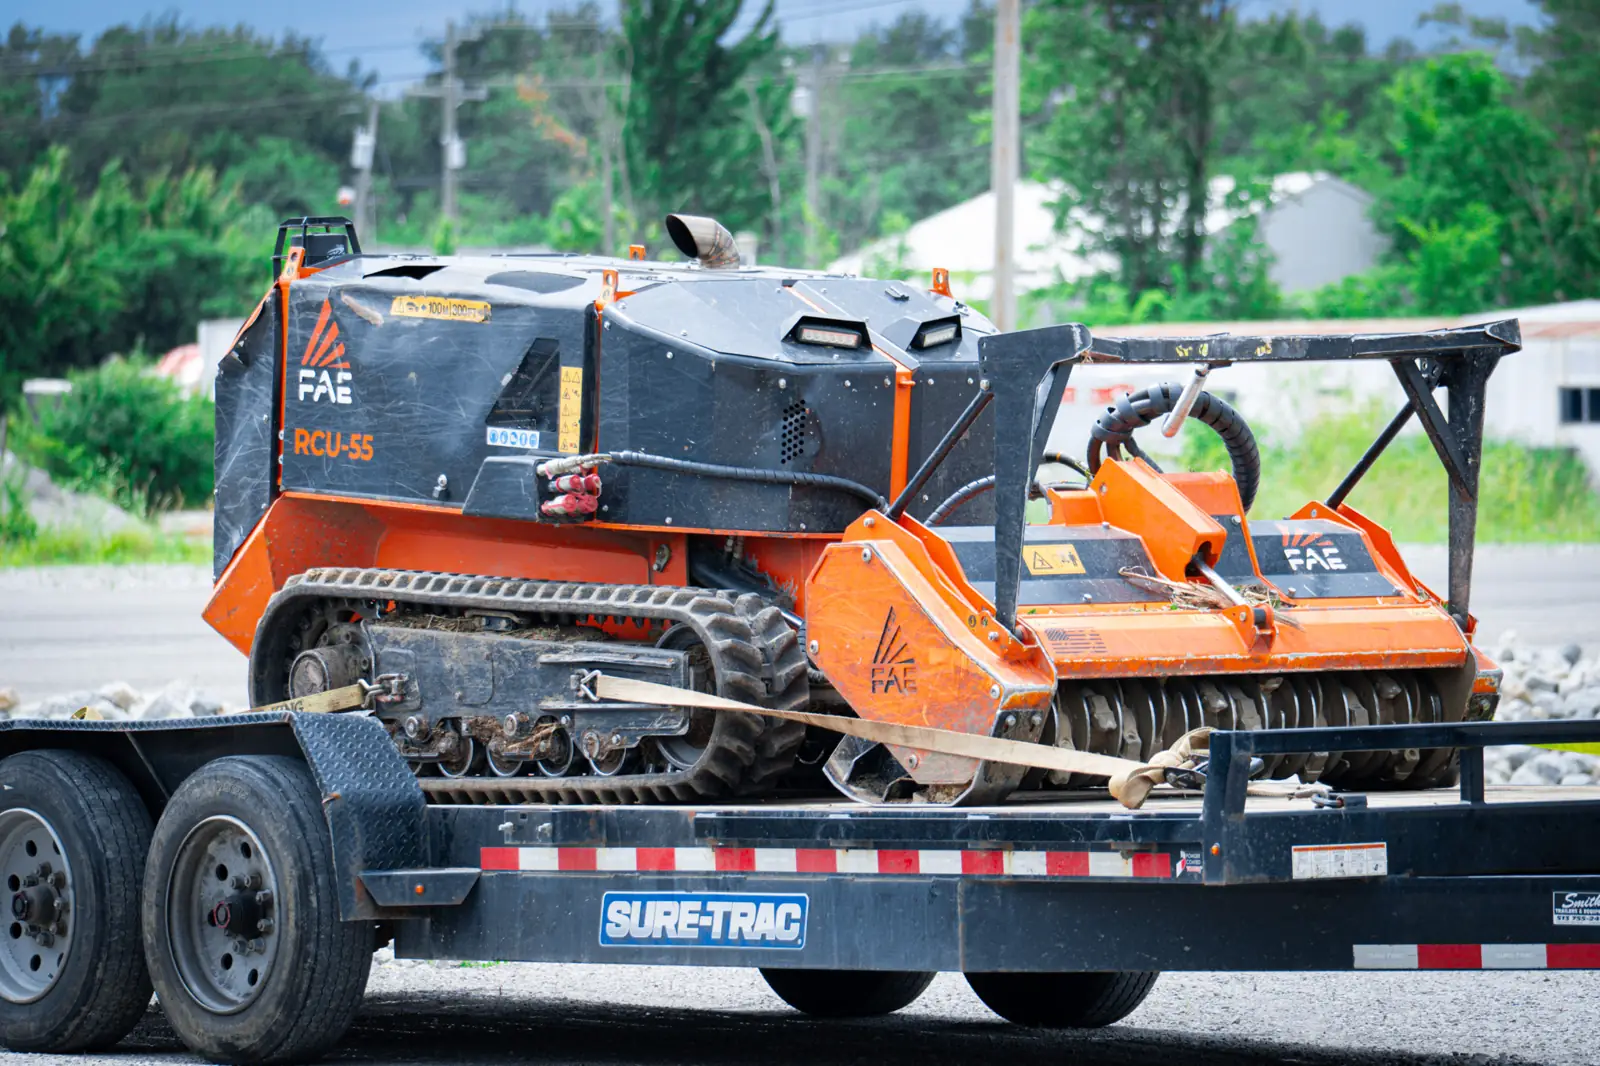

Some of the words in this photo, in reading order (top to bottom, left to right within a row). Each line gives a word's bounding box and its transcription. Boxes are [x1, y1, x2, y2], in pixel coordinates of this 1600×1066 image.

[299, 369, 352, 404] FAE
[294, 428, 374, 460] RCU-55
[1283, 547, 1347, 571] FAE
[871, 667, 917, 693] FAE
[606, 900, 802, 941] SURE-TRAC
